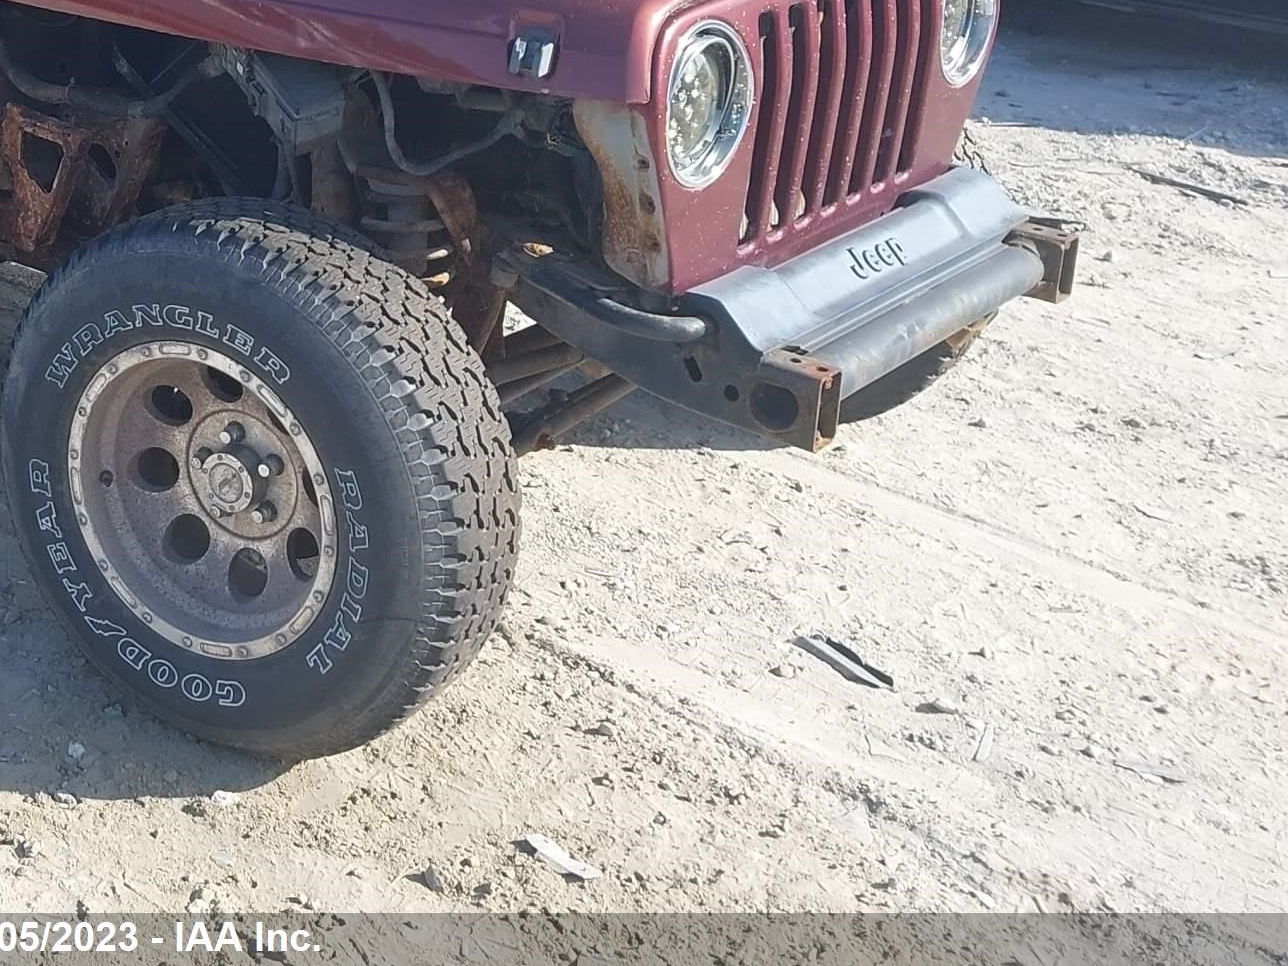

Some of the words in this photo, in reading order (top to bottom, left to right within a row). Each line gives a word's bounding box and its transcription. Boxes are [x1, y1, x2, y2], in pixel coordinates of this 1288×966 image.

[845, 236, 908, 280] Jeep
[44, 303, 292, 389] WRANGLER
[305, 466, 371, 675] RADIAL
